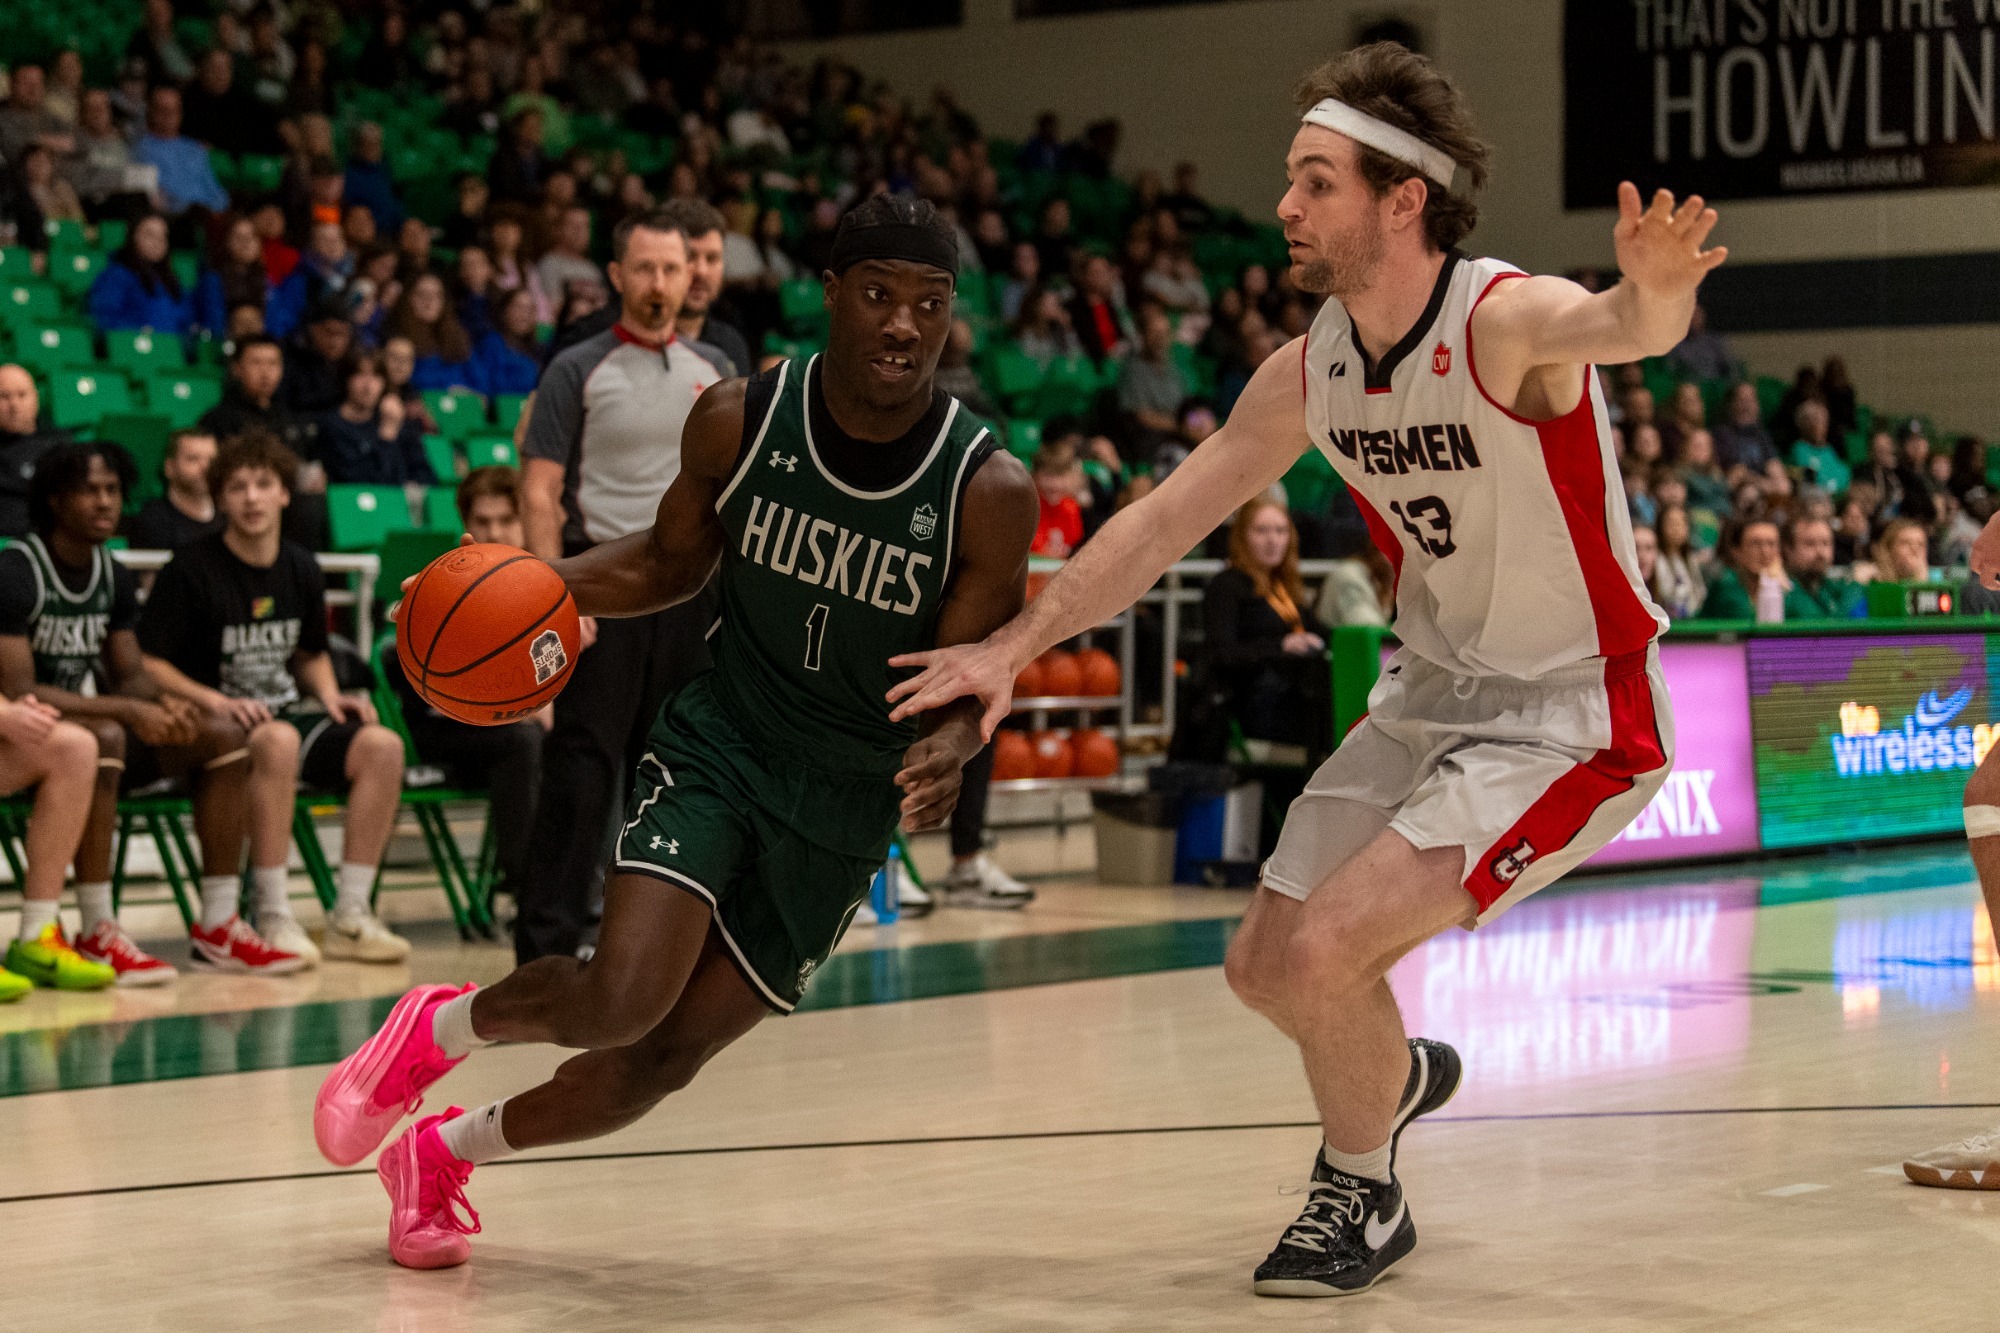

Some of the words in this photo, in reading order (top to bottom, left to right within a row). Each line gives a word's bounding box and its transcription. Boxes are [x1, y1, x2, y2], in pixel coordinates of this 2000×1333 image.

[1328, 423, 1482, 475] WESMEN
[913, 522, 932, 536] WEST
[1389, 495, 1458, 558] 13
[740, 495, 933, 616] HUSKIES
[535, 643, 563, 668] SPORTS
[804, 603, 830, 671] 1
[1839, 701, 1880, 737] the
[1333, 1173, 1360, 1189] BOOK
